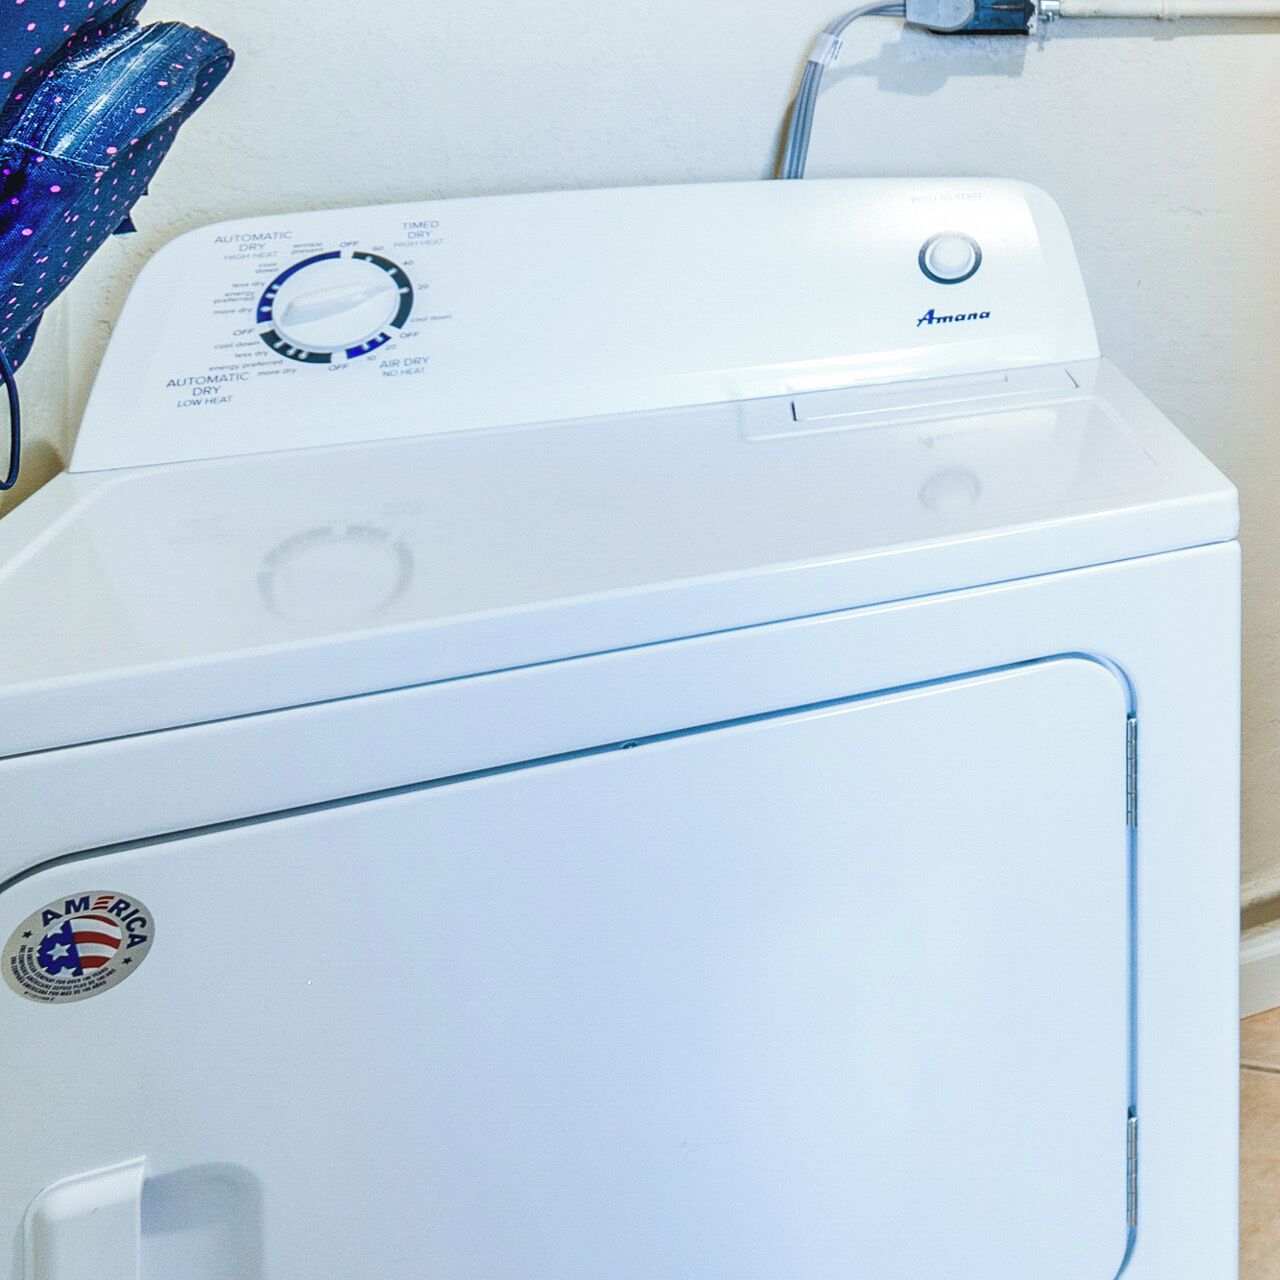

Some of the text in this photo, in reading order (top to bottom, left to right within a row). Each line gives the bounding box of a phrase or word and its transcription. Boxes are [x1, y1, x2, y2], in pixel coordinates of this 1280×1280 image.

[402, 220, 440, 231] TIMED
[213, 231, 293, 244] AUTOMATIC
[407, 230, 433, 239] DRY
[238, 243, 267, 252] DRY
[916, 308, 992, 328] Amana
[232, 328, 256, 337] OFF
[379, 356, 430, 369] AIR DRY
[382, 367, 426, 377] NO HEAT
[165, 371, 251, 388] AUTOMATIC
[191, 385, 222, 397] DRY
[176, 395, 234, 408] LOW HEAT
[41, 895, 149, 950] AMERICA
